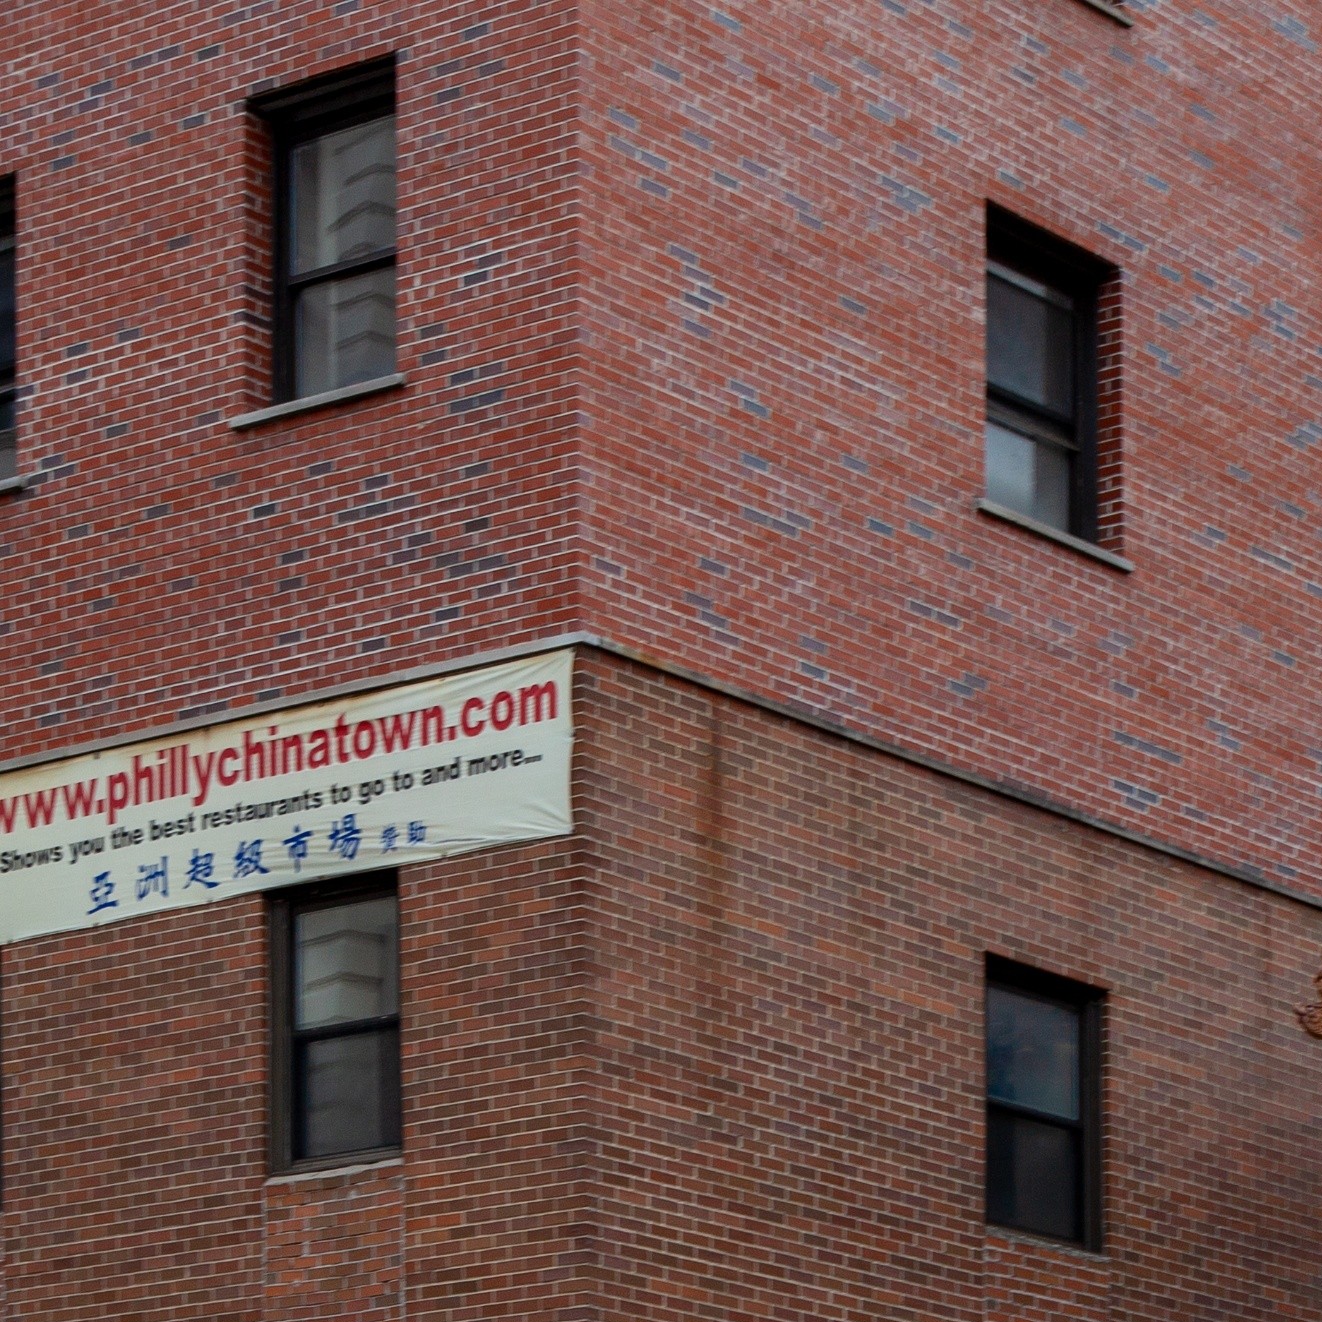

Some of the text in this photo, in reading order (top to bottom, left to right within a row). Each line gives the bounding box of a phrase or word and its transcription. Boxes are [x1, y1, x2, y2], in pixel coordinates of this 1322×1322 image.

[0, 845, 64, 873] Shows
[69, 836, 105, 864] you
[111, 827, 144, 850] the
[149, 812, 196, 841] best
[201, 788, 323, 831] restaurants
[330, 783, 352, 805] to
[359, 779, 385, 804] go
[391, 770, 414, 792] to
[422, 756, 461, 786] and
[86, 813, 363, 915] 亞洲超級市場
